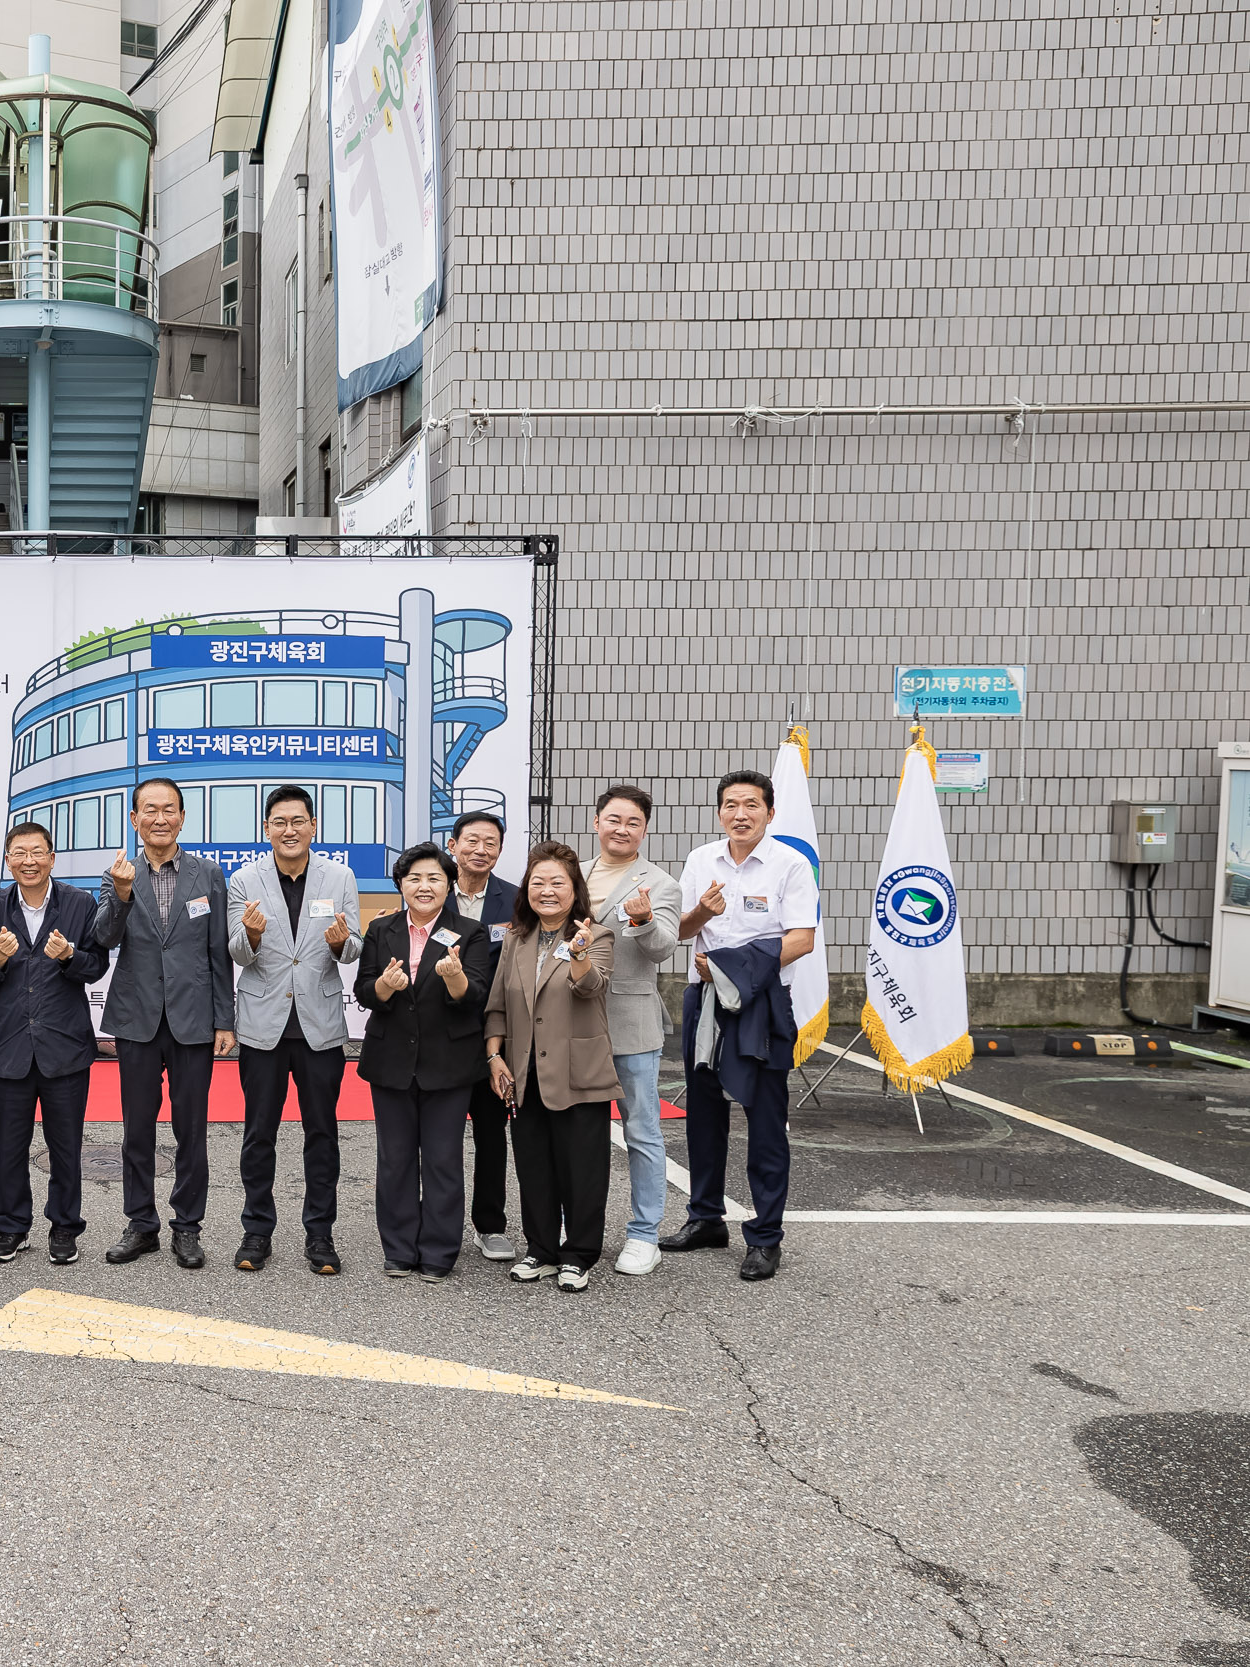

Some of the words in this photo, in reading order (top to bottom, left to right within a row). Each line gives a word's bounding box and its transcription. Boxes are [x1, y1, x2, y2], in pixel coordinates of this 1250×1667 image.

[209, 640, 325, 663] 광진구체육회
[971, 696, 1009, 706] 주차금지)
[156, 734, 378, 757] 광진구체육인커뮤니티센터
